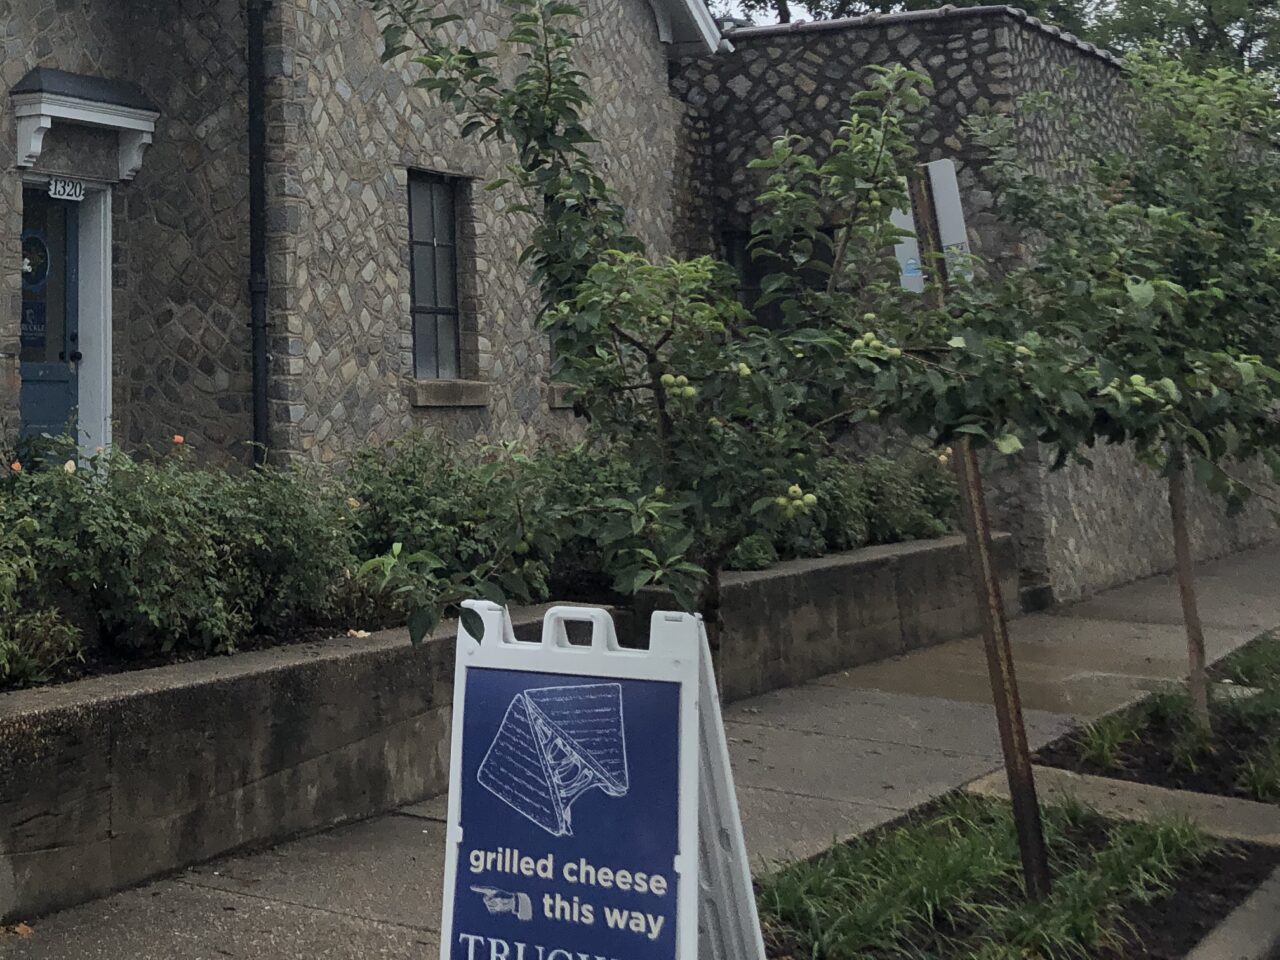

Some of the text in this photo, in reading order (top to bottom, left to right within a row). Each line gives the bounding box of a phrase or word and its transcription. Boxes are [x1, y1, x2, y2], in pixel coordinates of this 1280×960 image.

[53, 180, 82, 198] 1320
[469, 847, 668, 896] grilled cheese
[542, 893, 665, 940] this way
